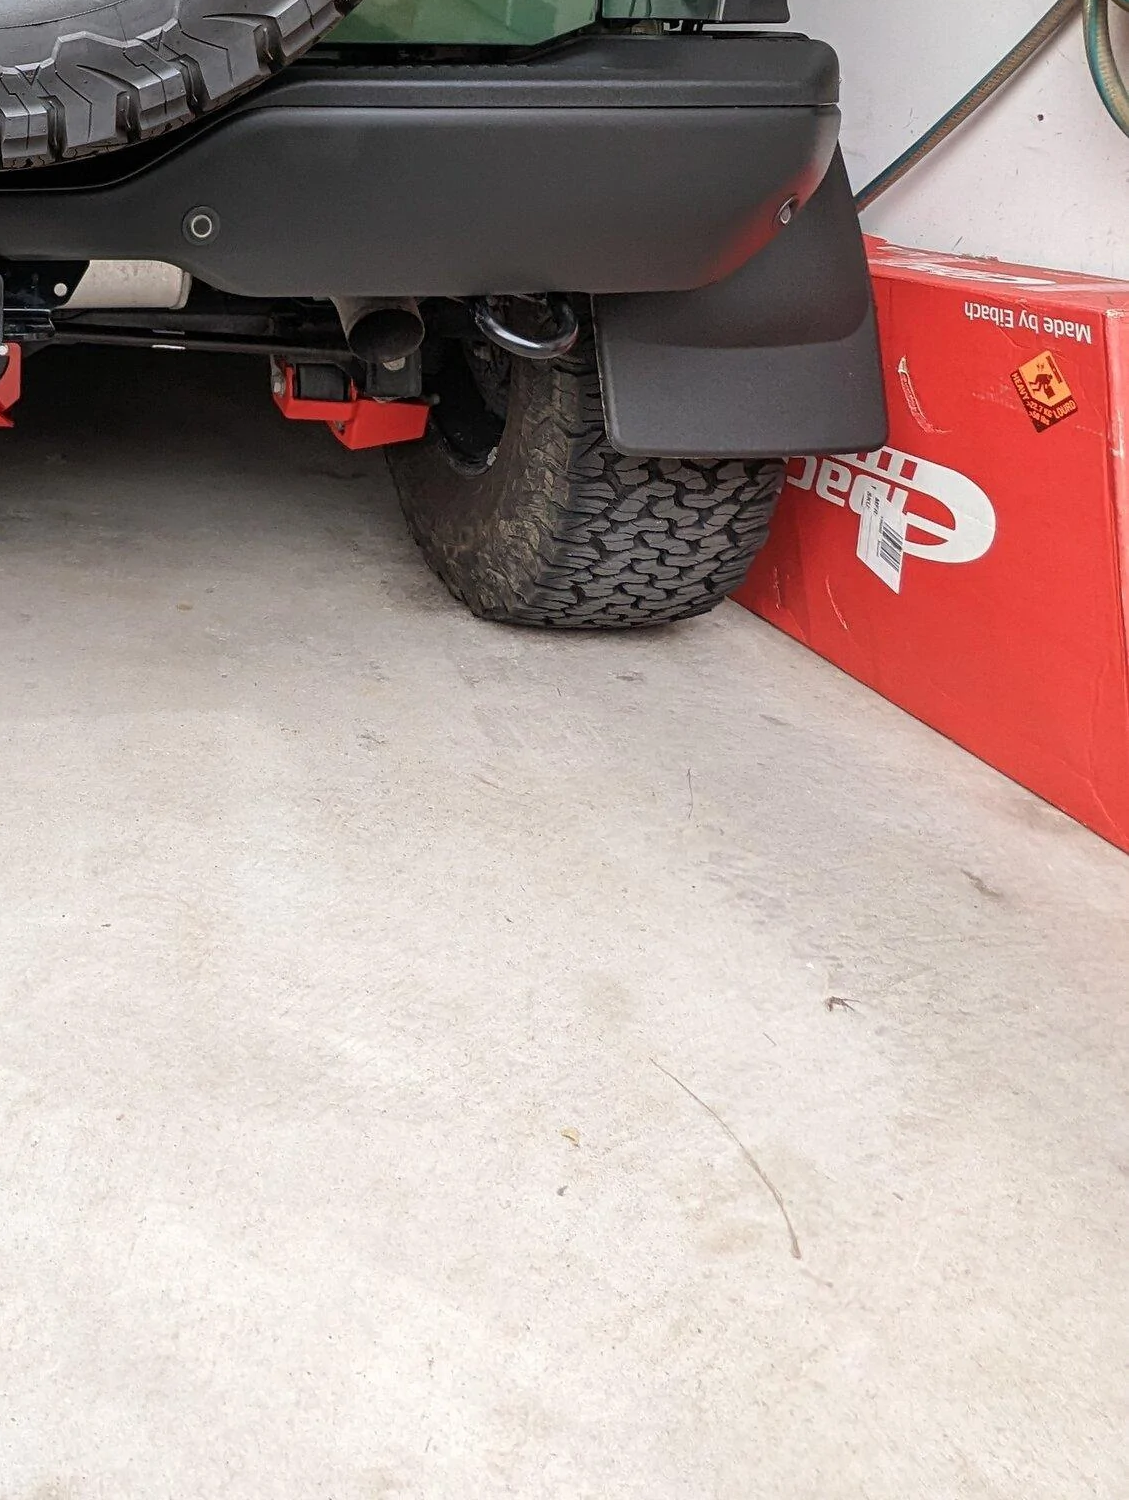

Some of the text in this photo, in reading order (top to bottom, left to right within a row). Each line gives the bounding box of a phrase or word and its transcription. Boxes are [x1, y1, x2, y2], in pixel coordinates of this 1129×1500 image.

[964, 300, 1093, 345] Made by Eibach
[1011, 371, 1030, 401] HEAVY
[1053, 399, 1077, 419] LOURD
